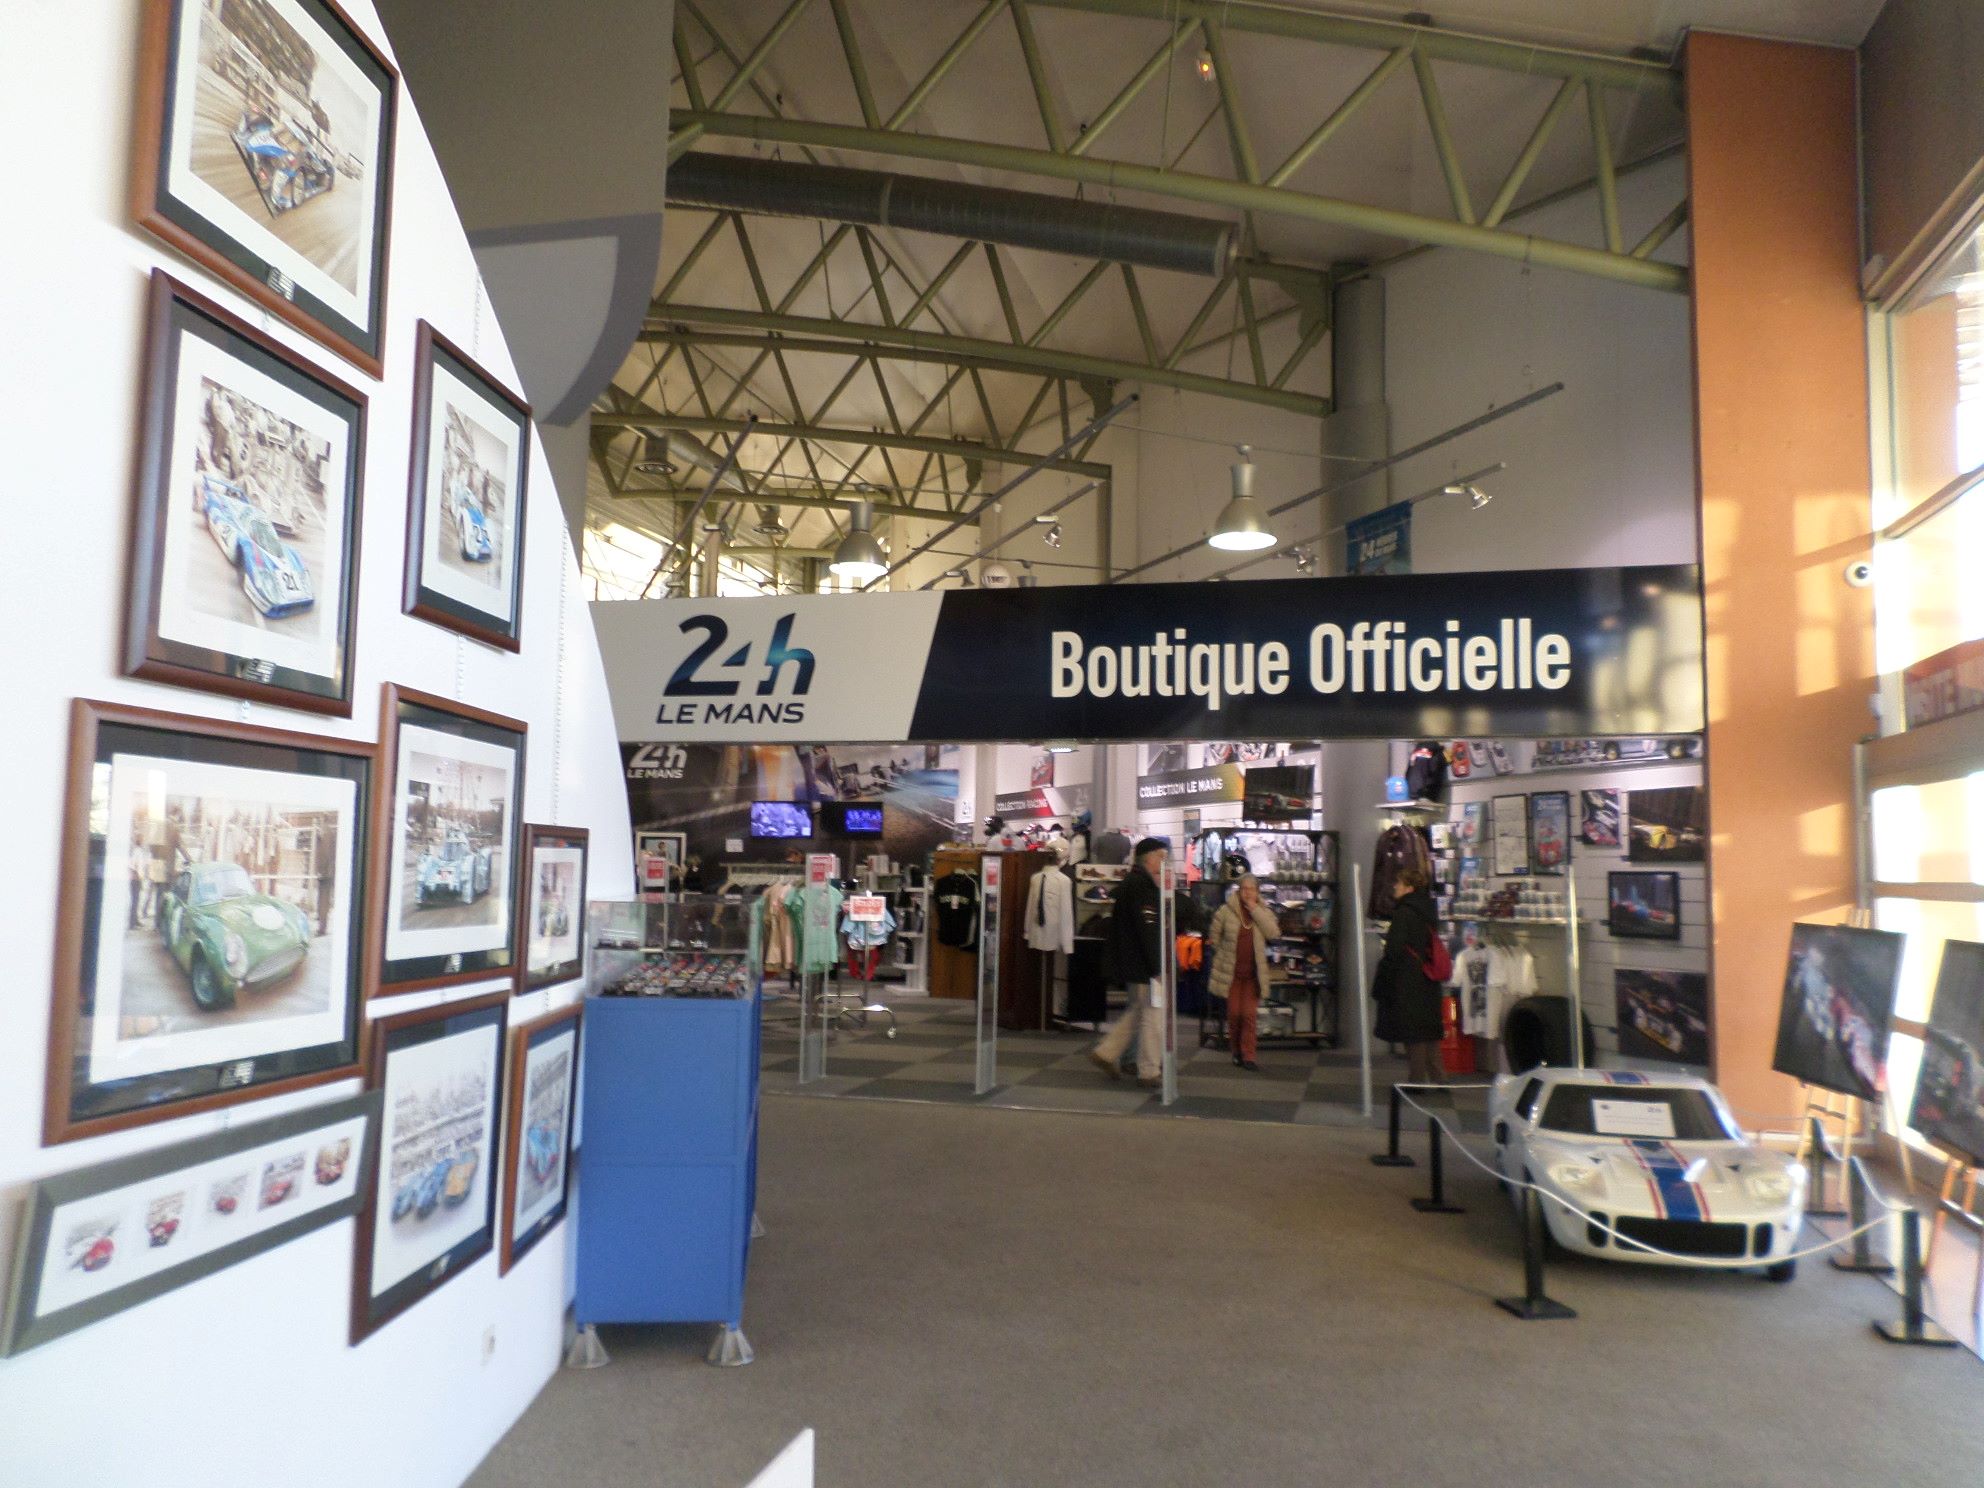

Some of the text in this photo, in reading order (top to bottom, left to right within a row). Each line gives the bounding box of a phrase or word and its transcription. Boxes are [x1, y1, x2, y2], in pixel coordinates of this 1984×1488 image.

[661, 612, 816, 698] 24h
[1051, 617, 1571, 711] Boutique Officielle
[655, 702, 805, 725] LE MANS
[626, 768, 684, 779] LE MANS
[1139, 777, 1224, 798] COLLECTION LE MANS
[996, 800, 1026, 812] COLLECTION
